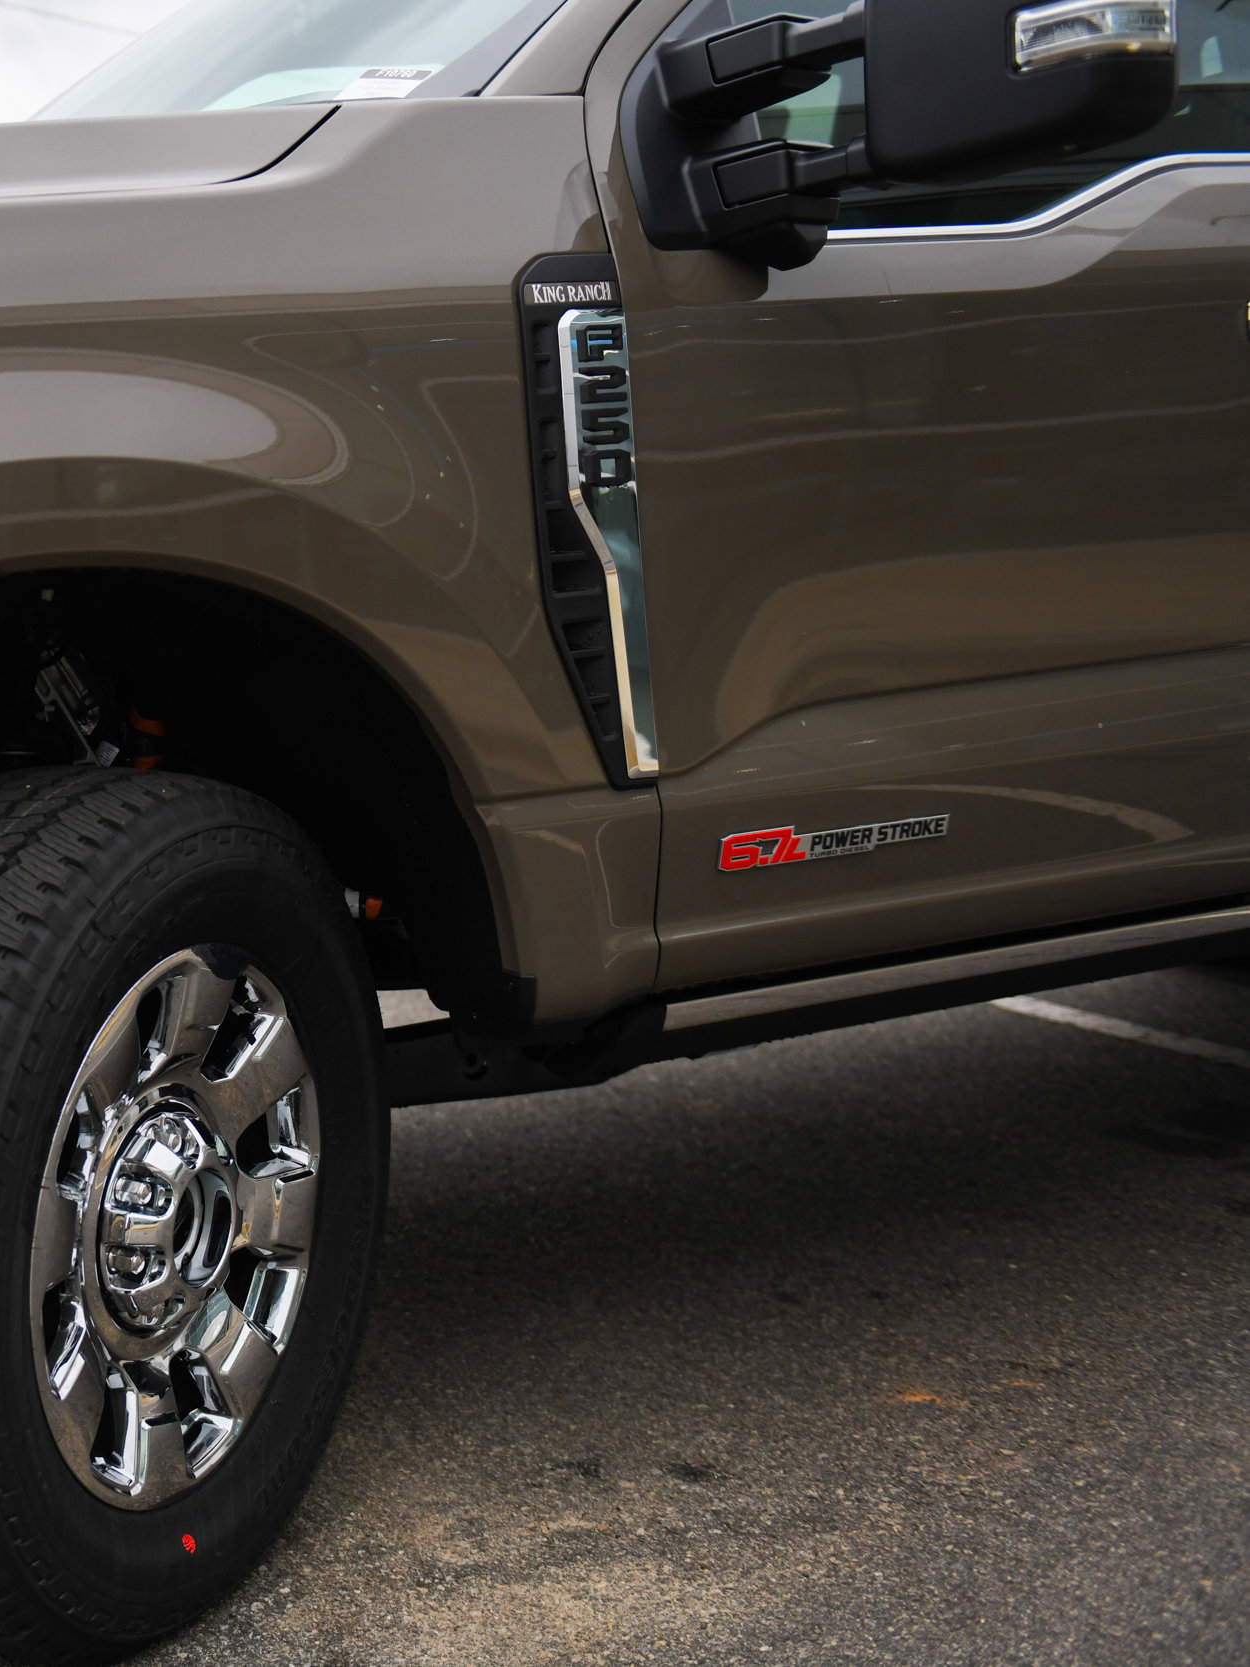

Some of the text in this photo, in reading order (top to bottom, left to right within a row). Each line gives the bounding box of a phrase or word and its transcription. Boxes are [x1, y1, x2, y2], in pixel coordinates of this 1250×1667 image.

[532, 281, 612, 304] KING RANCH
[576, 323, 632, 487] F250
[720, 816, 946, 871] 6.7L POWER STROKE
[809, 845, 870, 858] TURBO DIESEL
